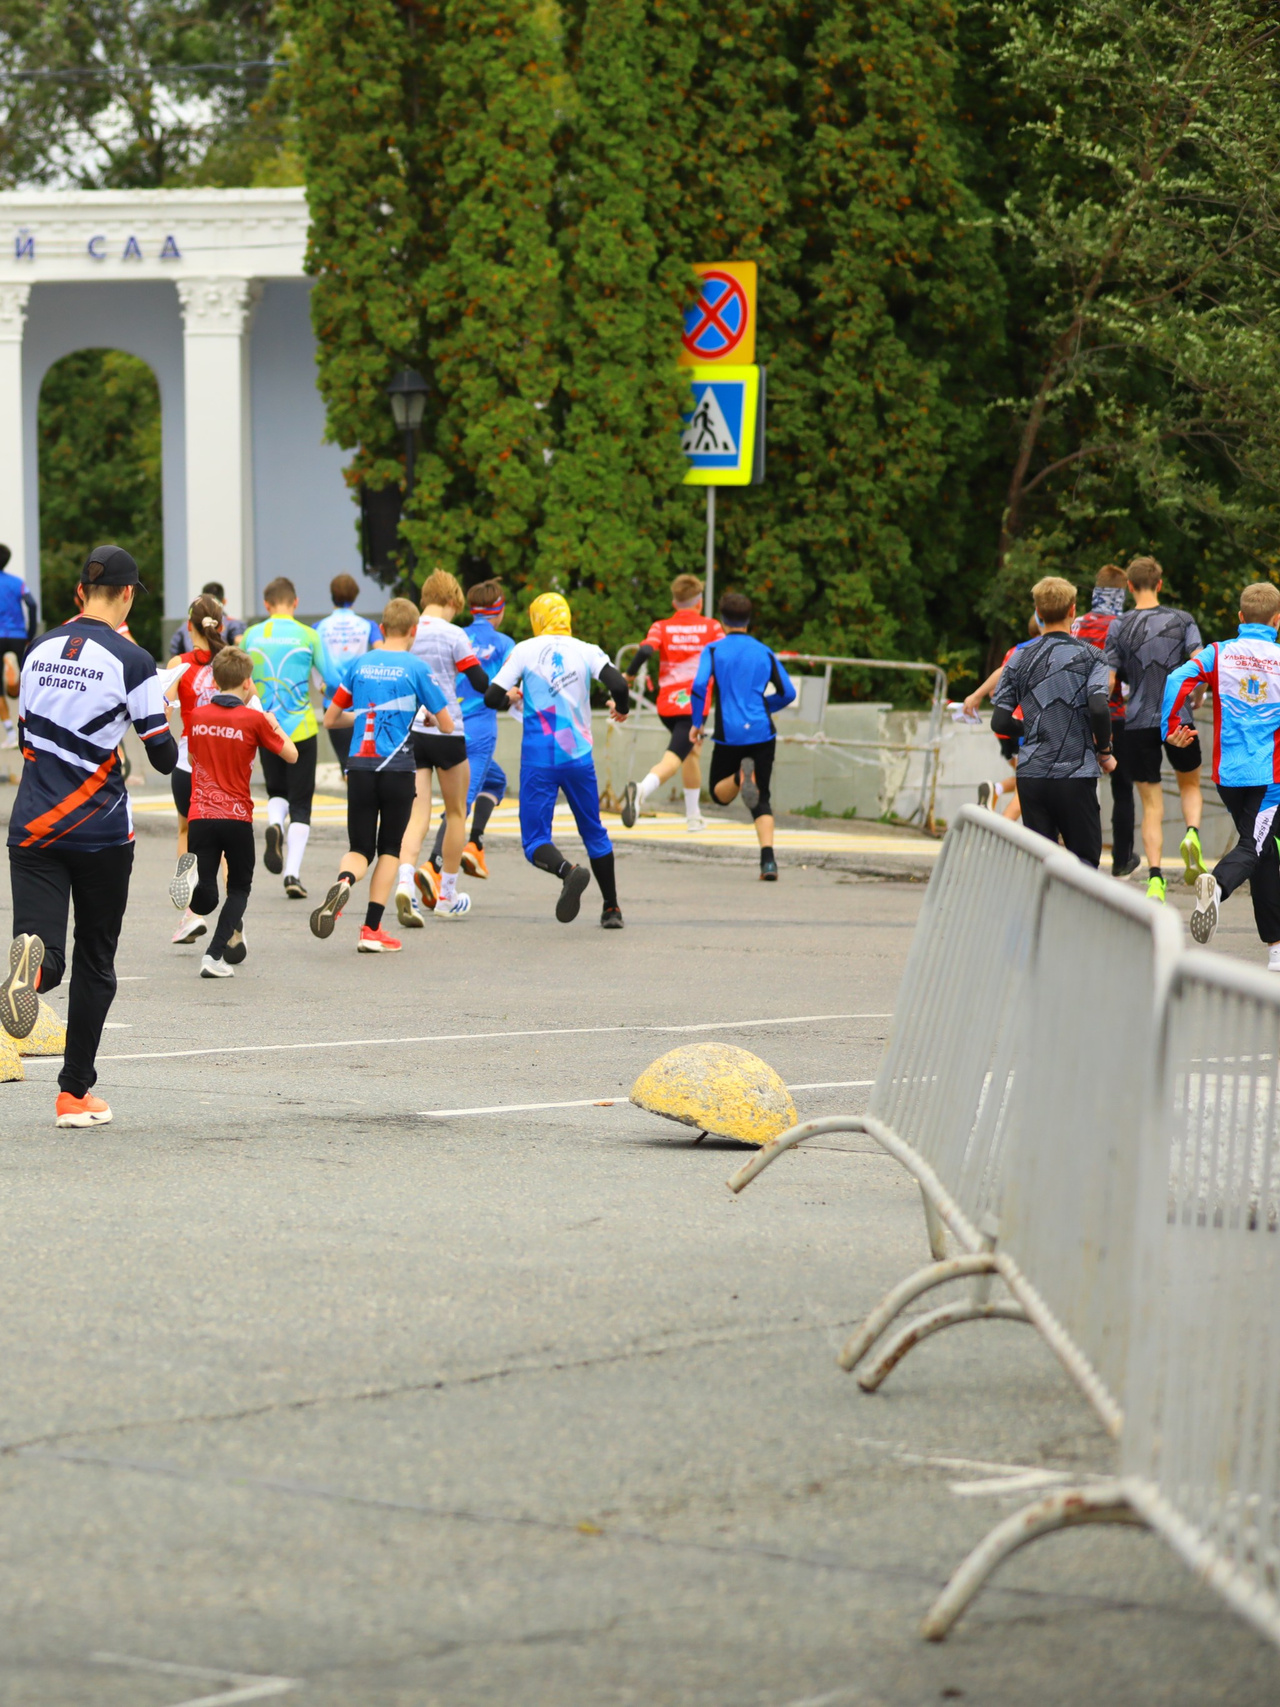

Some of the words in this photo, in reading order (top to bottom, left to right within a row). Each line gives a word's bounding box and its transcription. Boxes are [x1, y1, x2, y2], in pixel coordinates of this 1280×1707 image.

[87, 235, 182, 261] САД
[1223, 654, 1280, 667] УЛЬЯНОВСКА
[31, 660, 105, 681] Ивановская
[38, 674, 87, 692] область
[192, 724, 244, 742] МОСКВА
